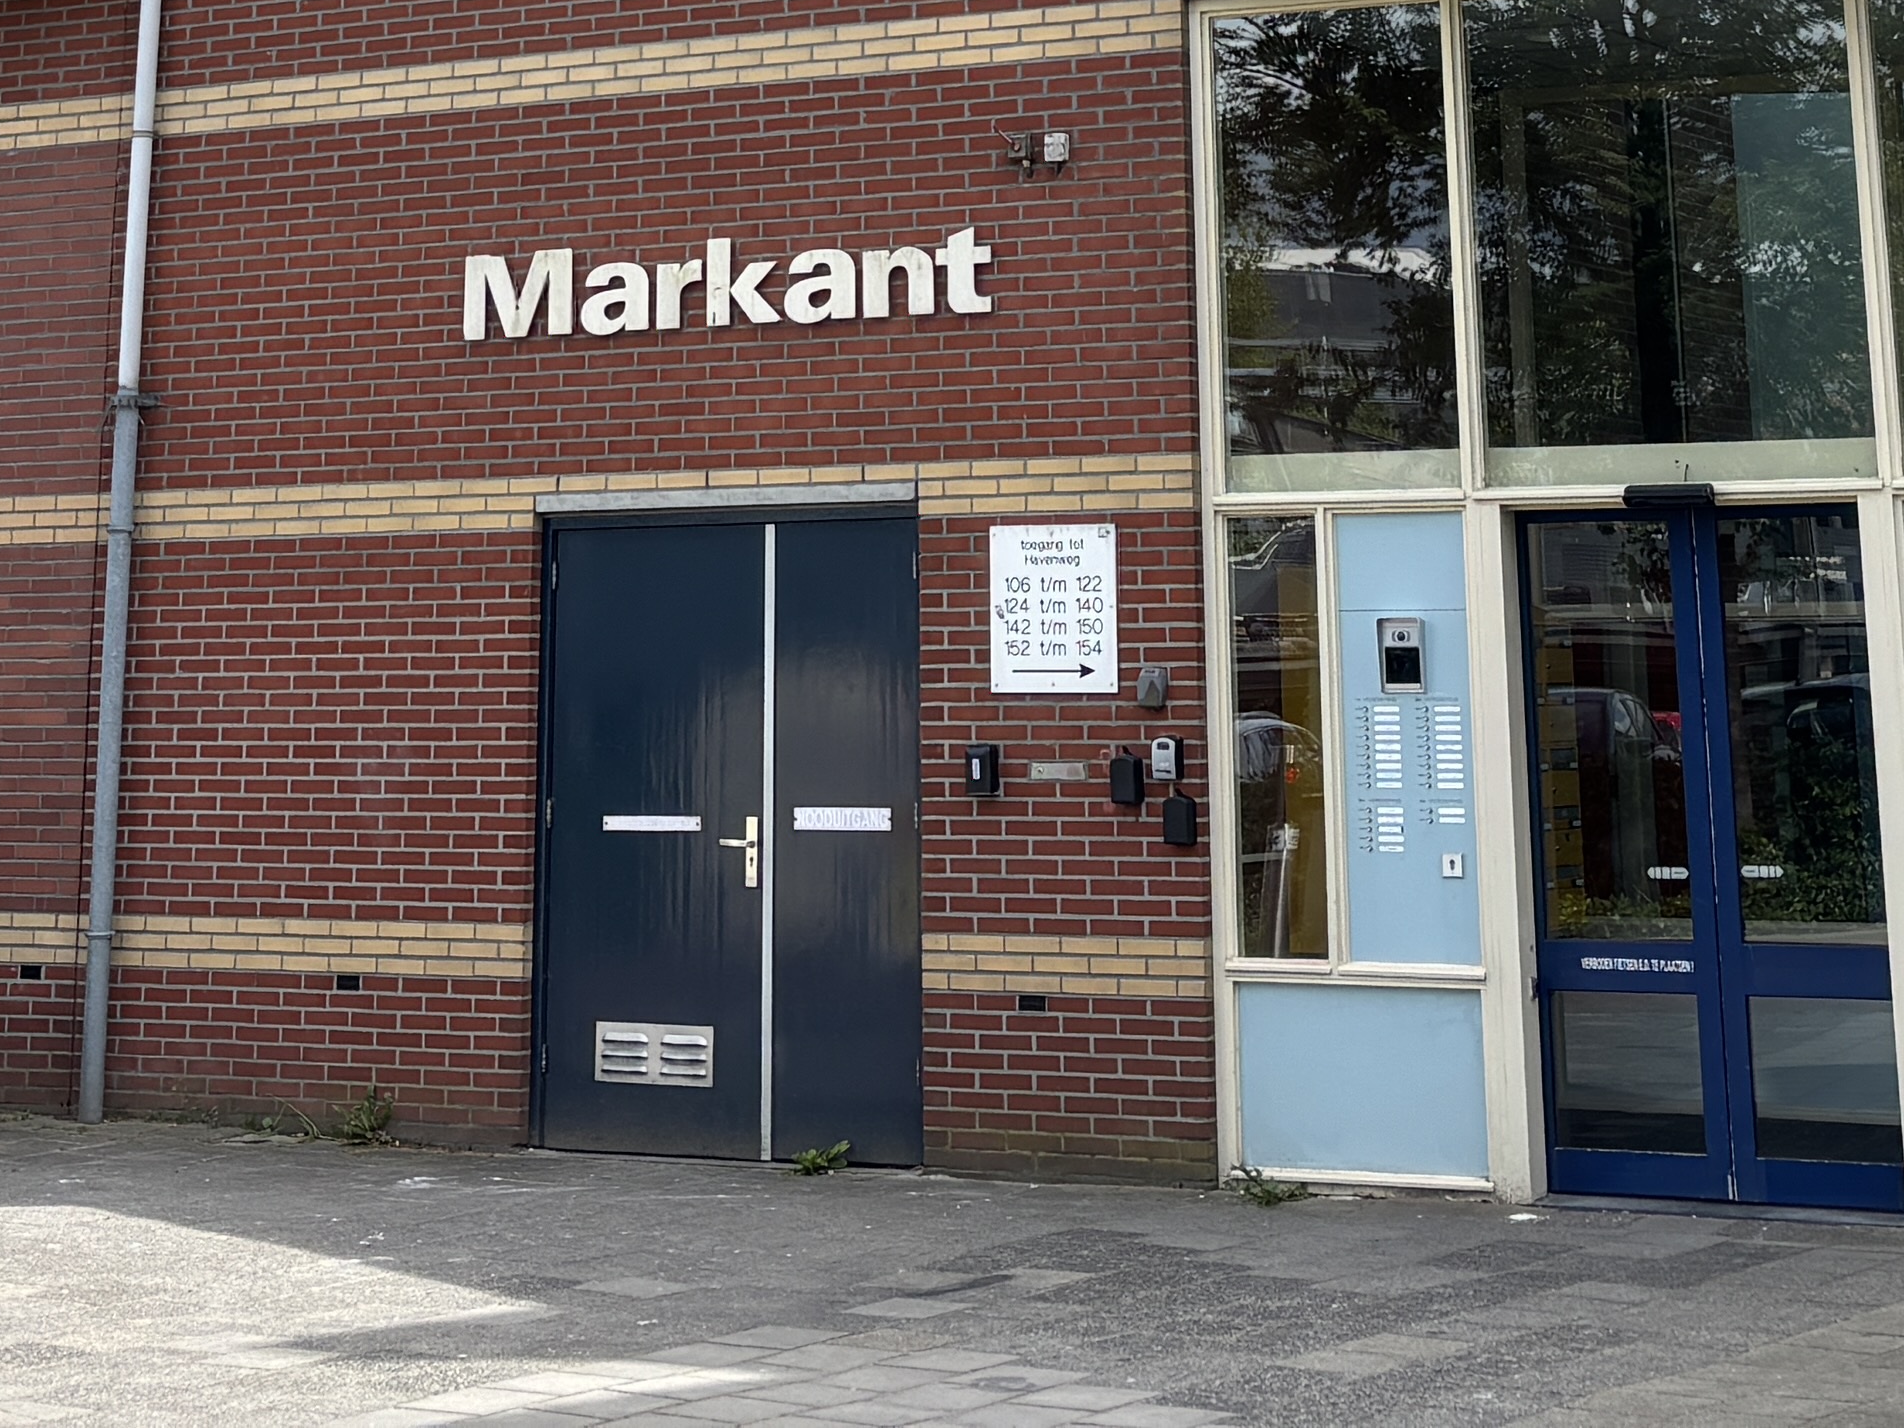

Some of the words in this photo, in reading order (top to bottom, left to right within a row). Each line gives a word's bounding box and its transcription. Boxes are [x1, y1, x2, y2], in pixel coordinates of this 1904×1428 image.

[462, 227, 992, 341] Markant
[1004, 576, 1031, 593] 106
[1040, 576, 1067, 593] t/m
[1076, 575, 1102, 592] 122
[1004, 598, 1030, 614] 124
[1039, 598, 1066, 614] t/m
[1075, 597, 1104, 614] 140
[1004, 619, 1031, 635] 142
[1040, 619, 1067, 635] t/m
[1076, 618, 1104, 635] 150
[1004, 640, 1031, 656] 152
[1040, 640, 1067, 656] t/m
[1076, 640, 1102, 656] 154
[798, 808, 889, 828] NOODUITGANG
